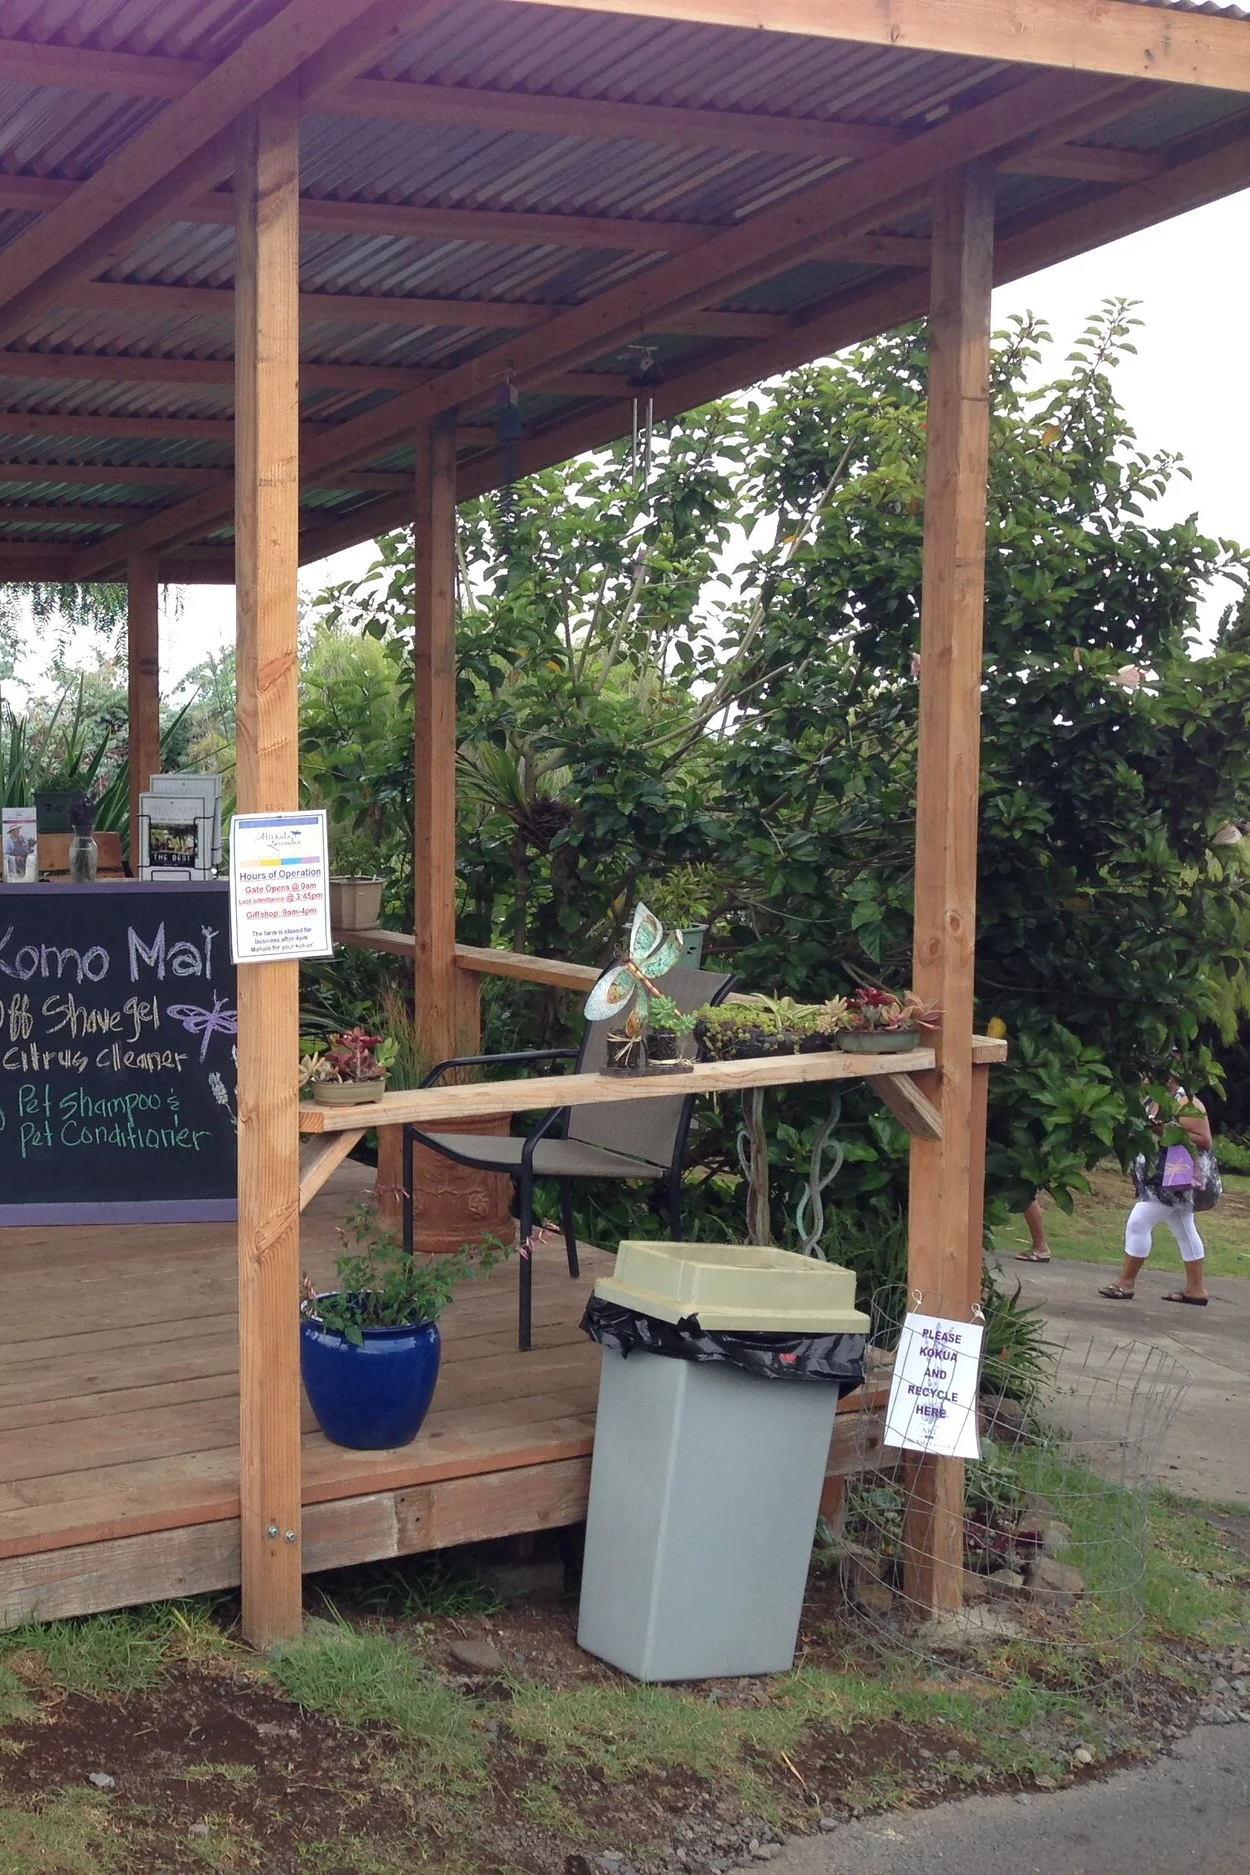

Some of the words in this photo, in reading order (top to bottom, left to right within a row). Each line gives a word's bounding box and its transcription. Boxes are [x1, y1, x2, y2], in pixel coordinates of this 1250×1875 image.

[172, 854, 191, 862] BEST
[240, 872, 266, 881] Hours
[268, 870, 277, 879] of
[279, 868, 321, 880] Operation
[245, 886, 264, 894] Gate
[265, 885, 290, 893] Opens
[291, 883, 299, 891] @
[300, 882, 317, 890] 9am
[286, 893, 294, 902] @
[296, 891, 323, 901] 3:45pm
[284, 927, 303, 935] closed
[127, 921, 219, 982] Mai
[281, 943, 294, 951] your
[18, 1084, 51, 1117] Pet
[19, 1122, 53, 1159] Pet
[61, 1119, 210, 1151] Conditioner
[921, 1328, 963, 1345] PLEASE
[919, 1347, 958, 1362] KOKUA
[924, 1367, 947, 1380] AND
[907, 1384, 959, 1403] RECYCLE
[915, 1405, 947, 1419] HERE
